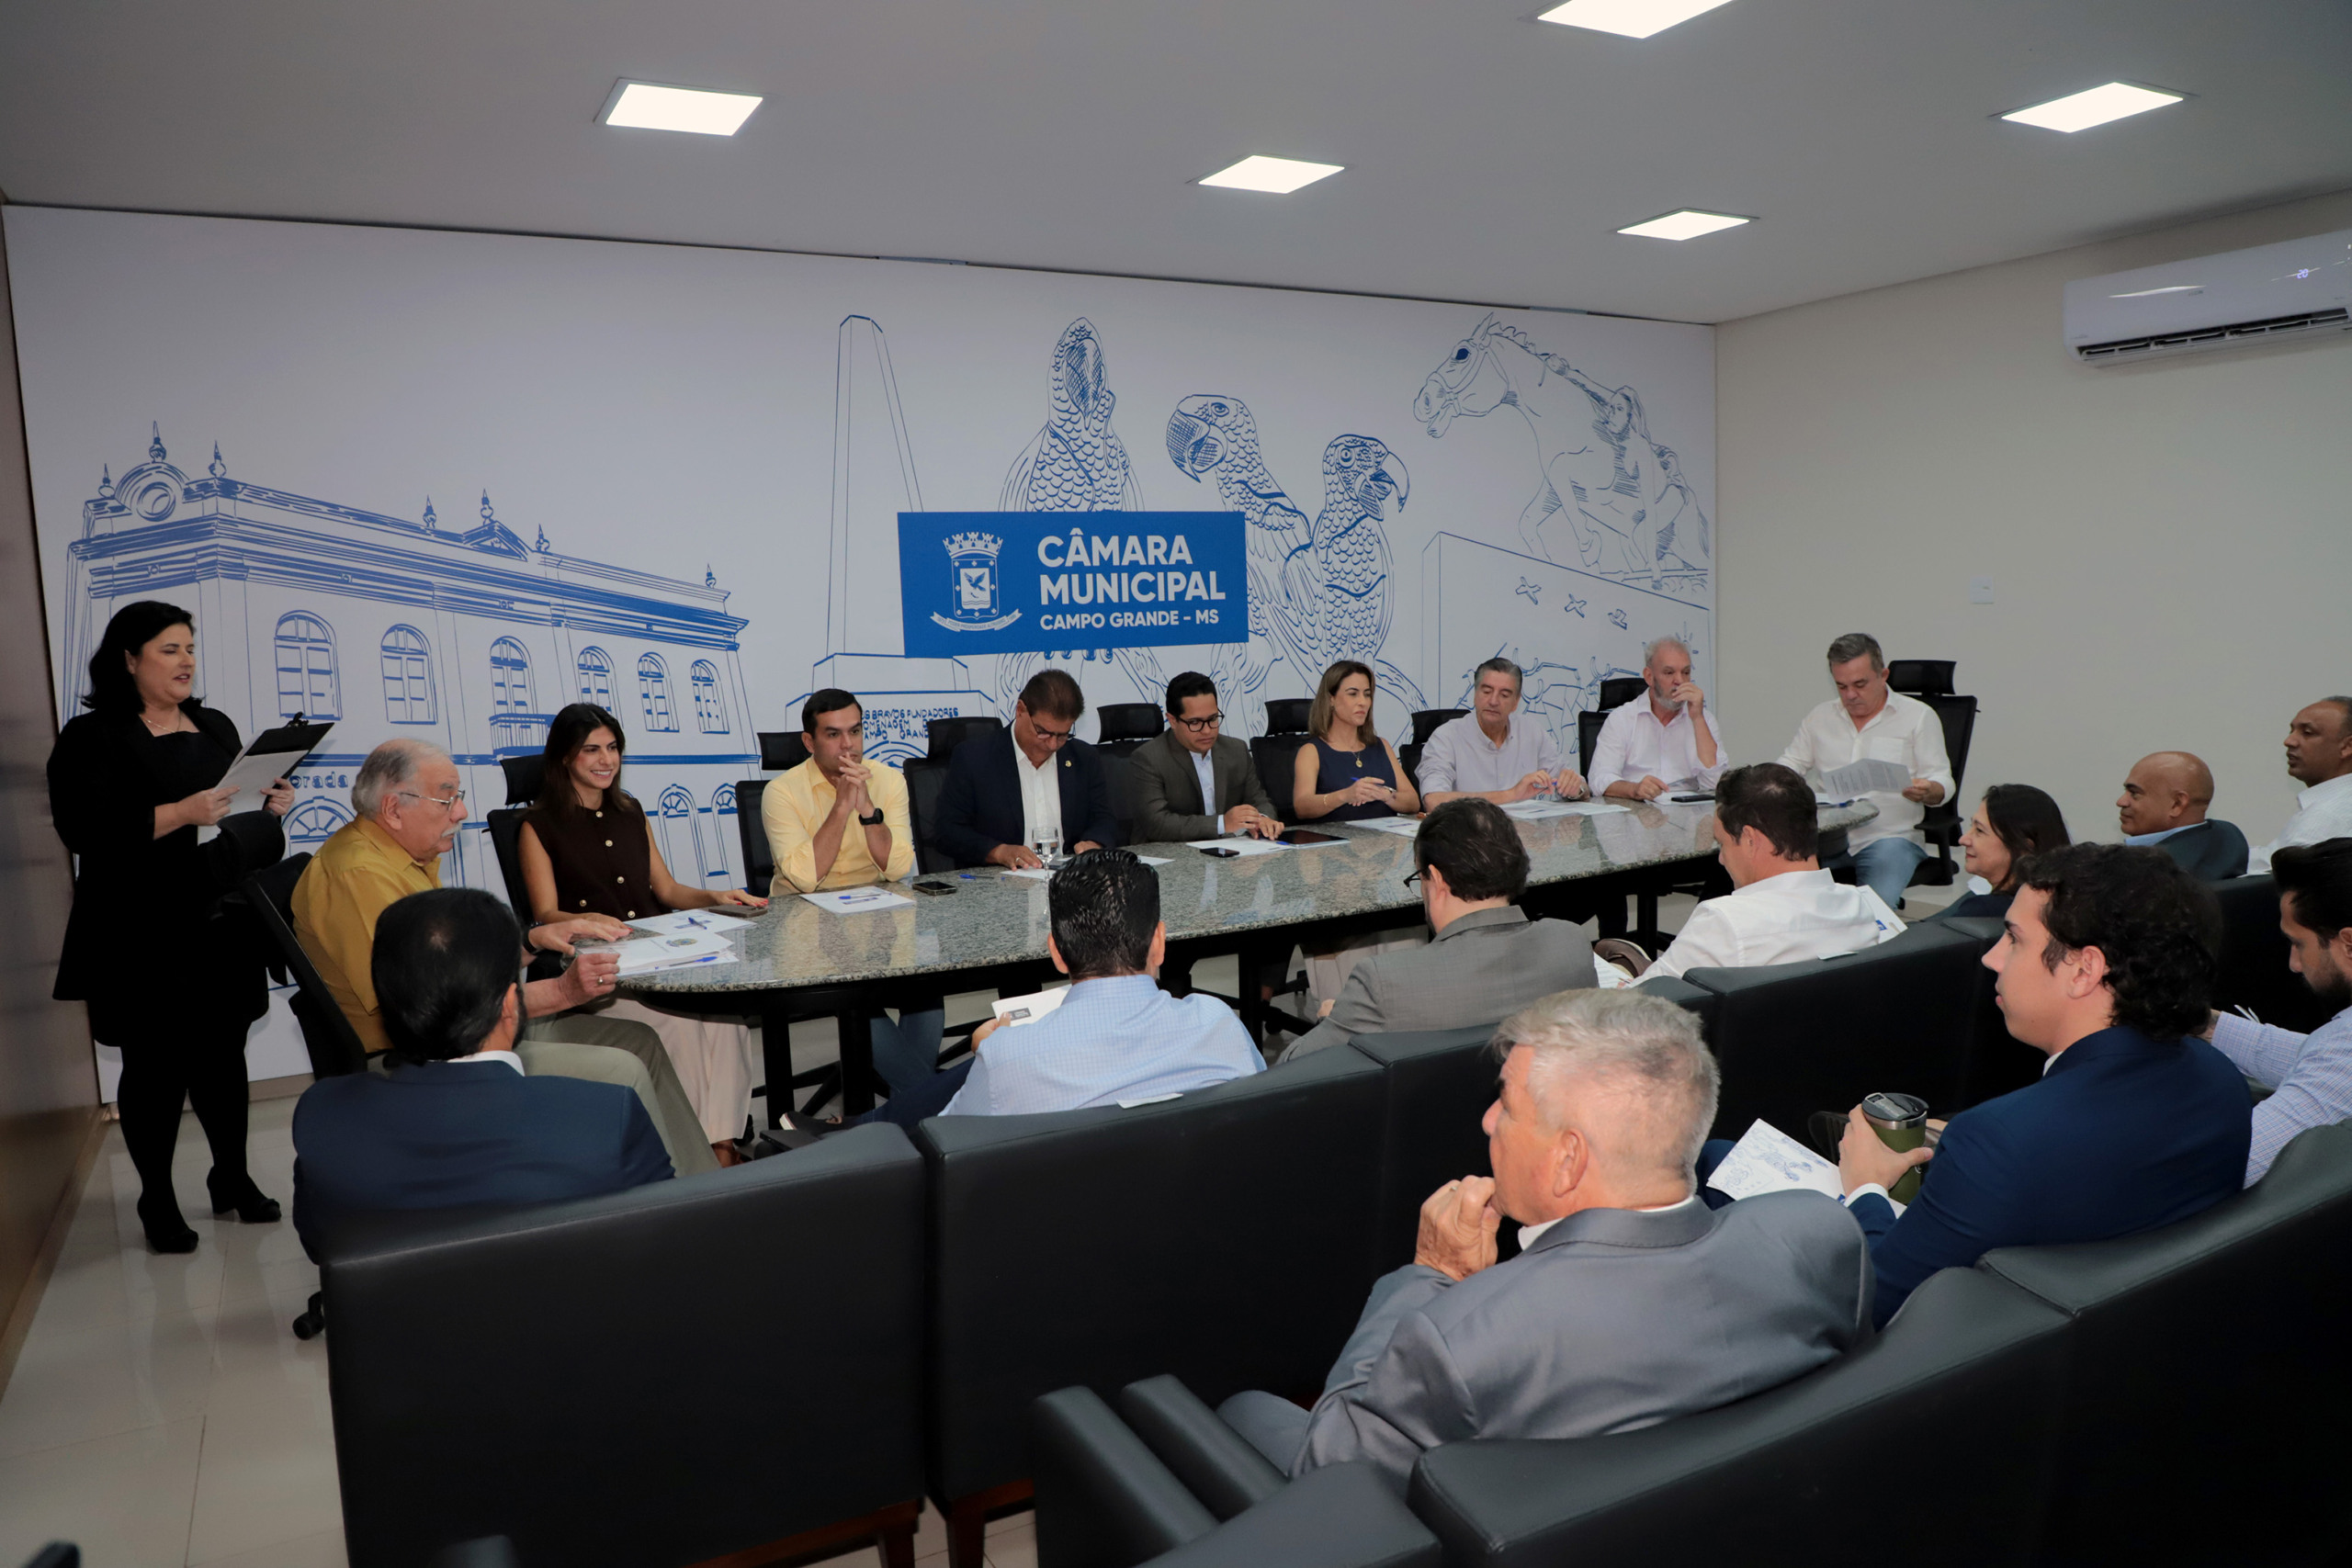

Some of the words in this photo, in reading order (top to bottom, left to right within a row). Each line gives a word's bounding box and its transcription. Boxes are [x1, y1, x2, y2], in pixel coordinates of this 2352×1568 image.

[2297, 268, 2309, 279] 20
[1037, 527, 1193, 568] CÂMARA
[1039, 570, 1227, 605] MUNICIPAL
[1040, 613, 1106, 630] CAMPO
[1109, 610, 1180, 627] GRANDE
[1195, 609, 1219, 625] MS
